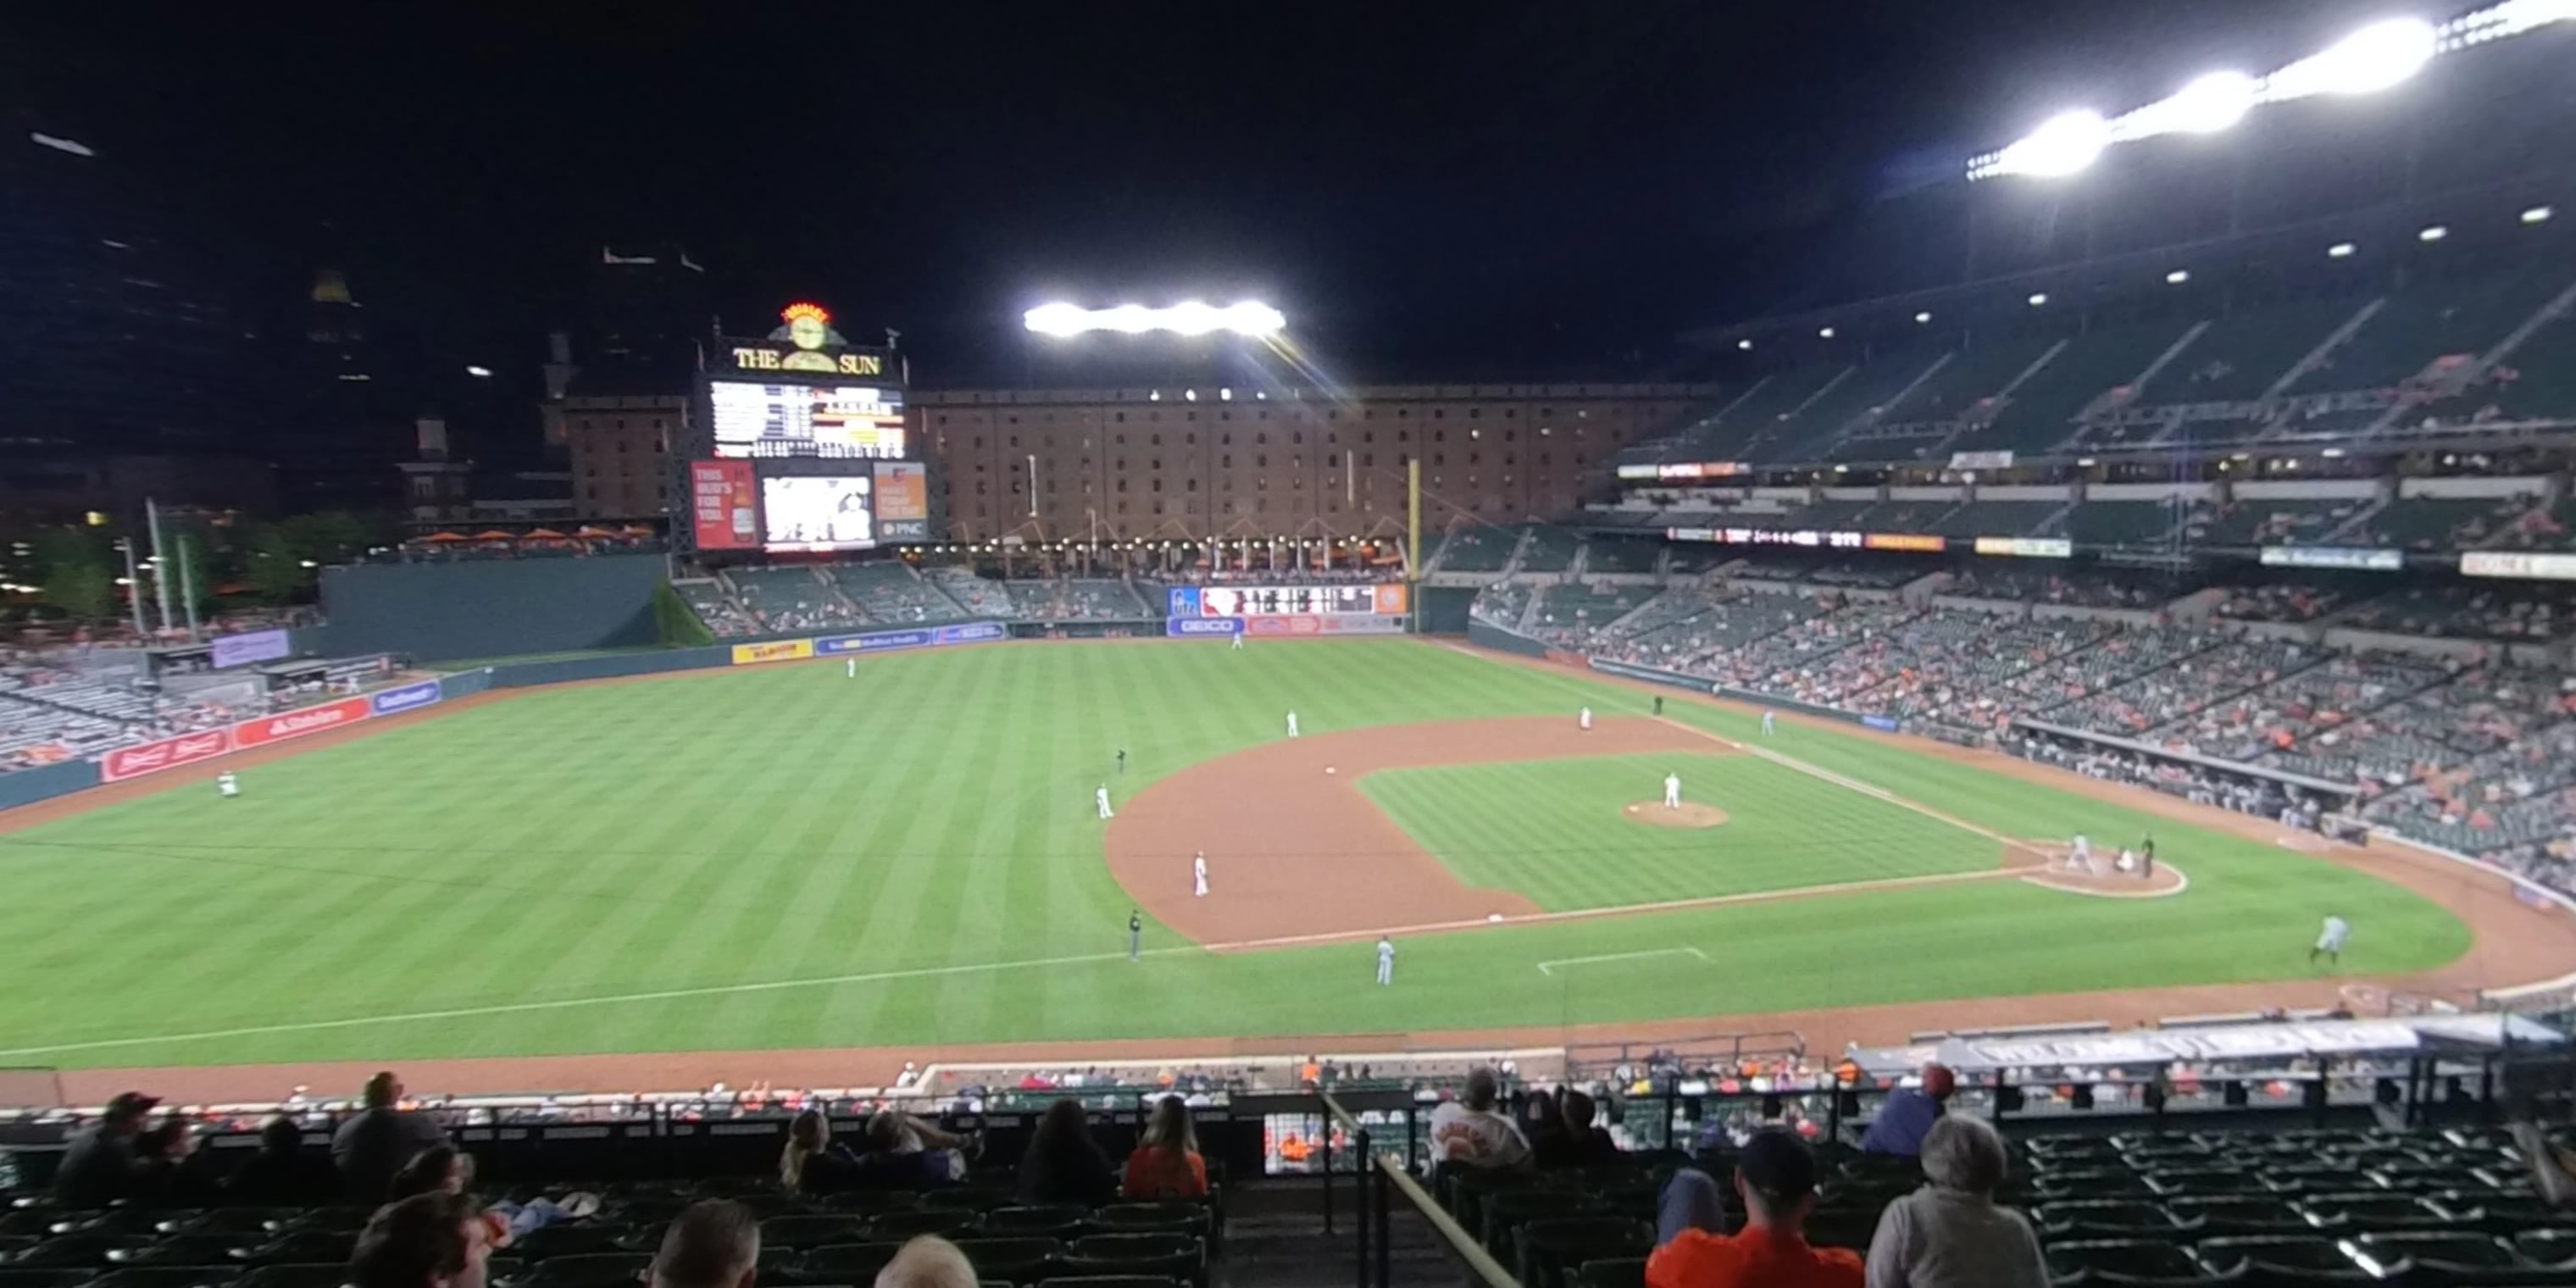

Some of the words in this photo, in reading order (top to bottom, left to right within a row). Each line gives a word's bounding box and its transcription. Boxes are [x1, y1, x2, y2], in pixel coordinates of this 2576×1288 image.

[733, 348, 780, 369] THE
[839, 354, 880, 375] SUN
[697, 496, 720, 507] FOR
[897, 523, 923, 535] PNC
[1181, 620, 1234, 632] GEICO
